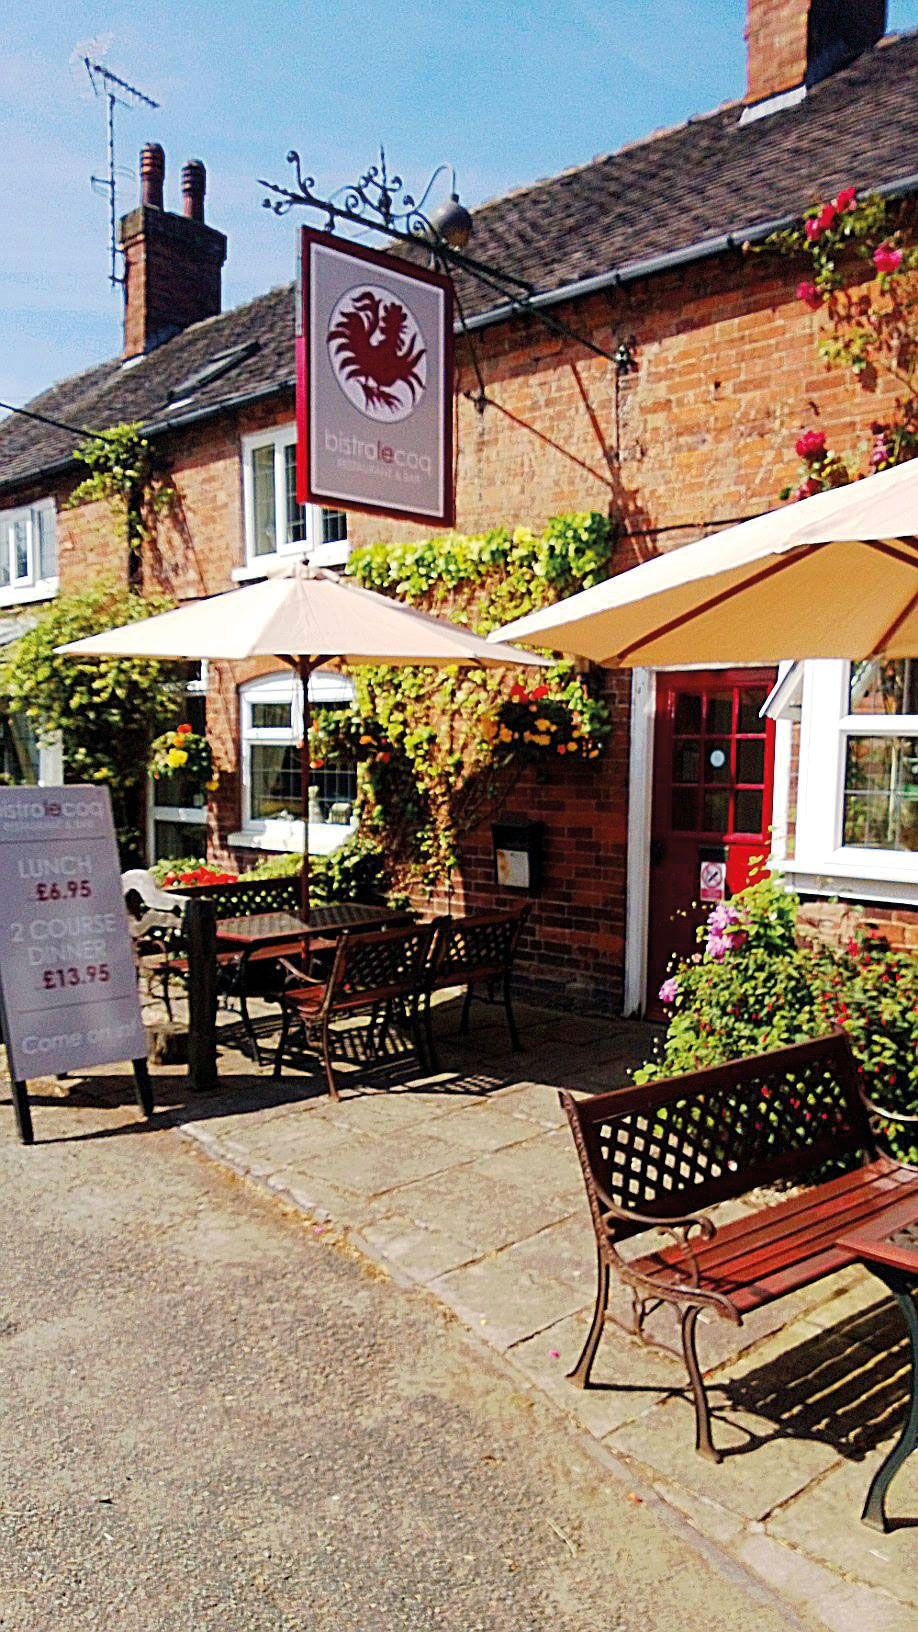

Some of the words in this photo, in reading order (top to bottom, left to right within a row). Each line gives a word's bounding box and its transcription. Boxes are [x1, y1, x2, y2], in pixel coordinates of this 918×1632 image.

[19, 855, 92, 878] LUNCH
[37, 880, 92, 902] £6.95
[11, 923, 25, 942] 2
[30, 913, 116, 940] COURSE
[28, 939, 106, 966] DINNER
[44, 964, 110, 990] £13.95
[22, 1032, 83, 1055] Come
